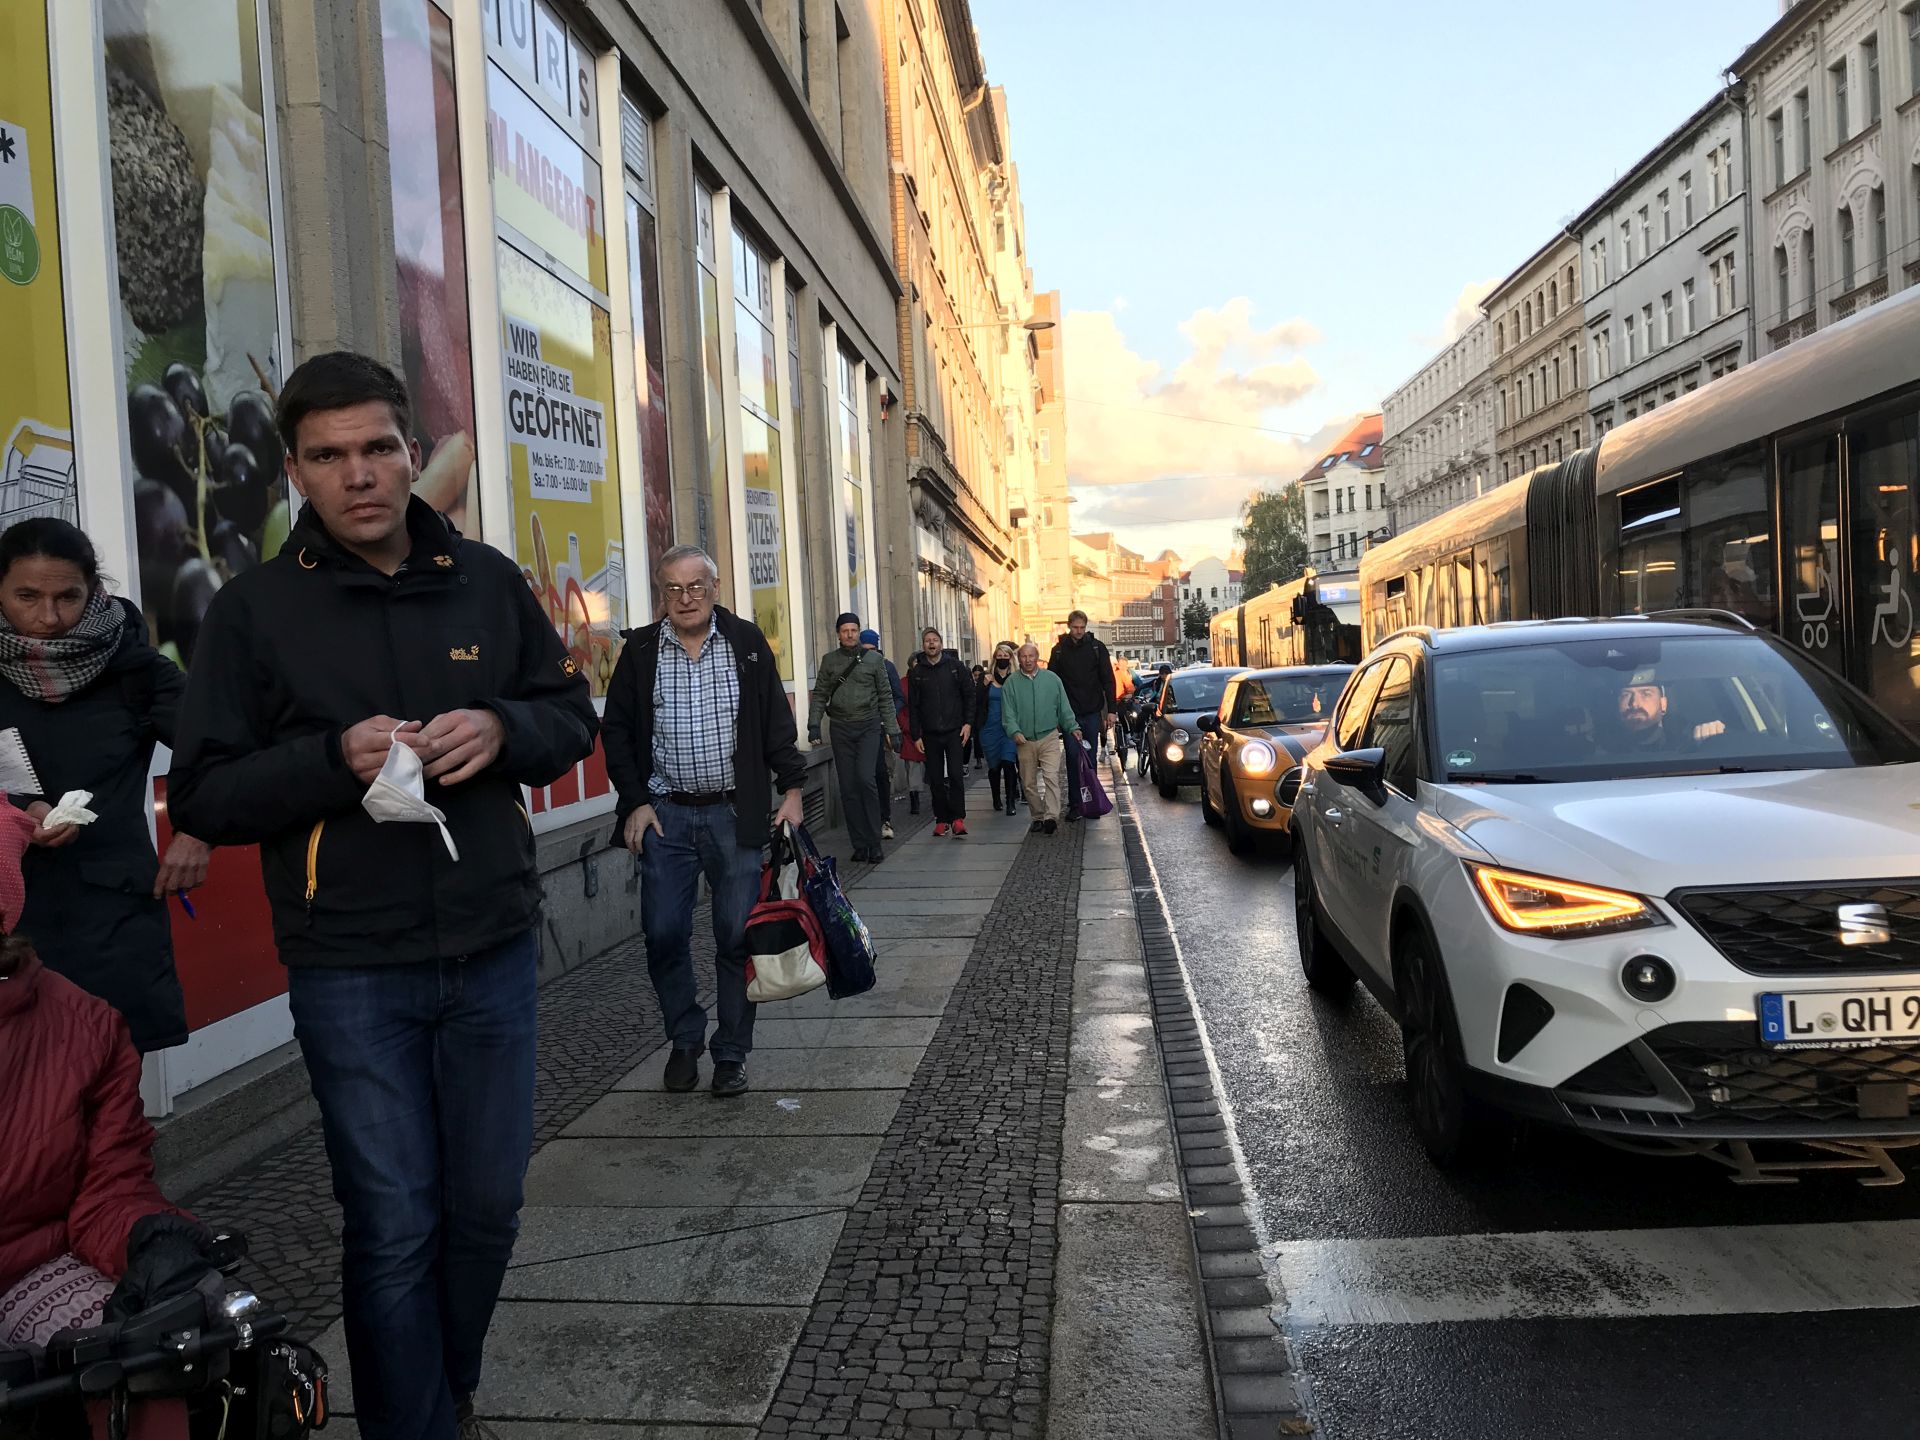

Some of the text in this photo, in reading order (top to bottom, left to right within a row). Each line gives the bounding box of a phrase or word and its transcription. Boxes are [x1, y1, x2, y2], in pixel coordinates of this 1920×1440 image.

[514, 131, 596, 247] ANGEBOT
[509, 323, 539, 361] WIR
[507, 356, 571, 393] HABEN FÜR SIE
[508, 386, 602, 449] GEÖFFNET
[532, 451, 545, 467] Mo.
[544, 453, 554, 469] bis
[563, 456, 576, 471] 7.00
[579, 459, 594, 474] 20.00
[594, 461, 603, 476] Uhr
[545, 473, 558, 489] 7.00
[562, 476, 578, 491] 16.00
[577, 478, 588, 492] Uhr
[1789, 1000, 1814, 1034] L
[1842, 997, 1893, 1032] QH
